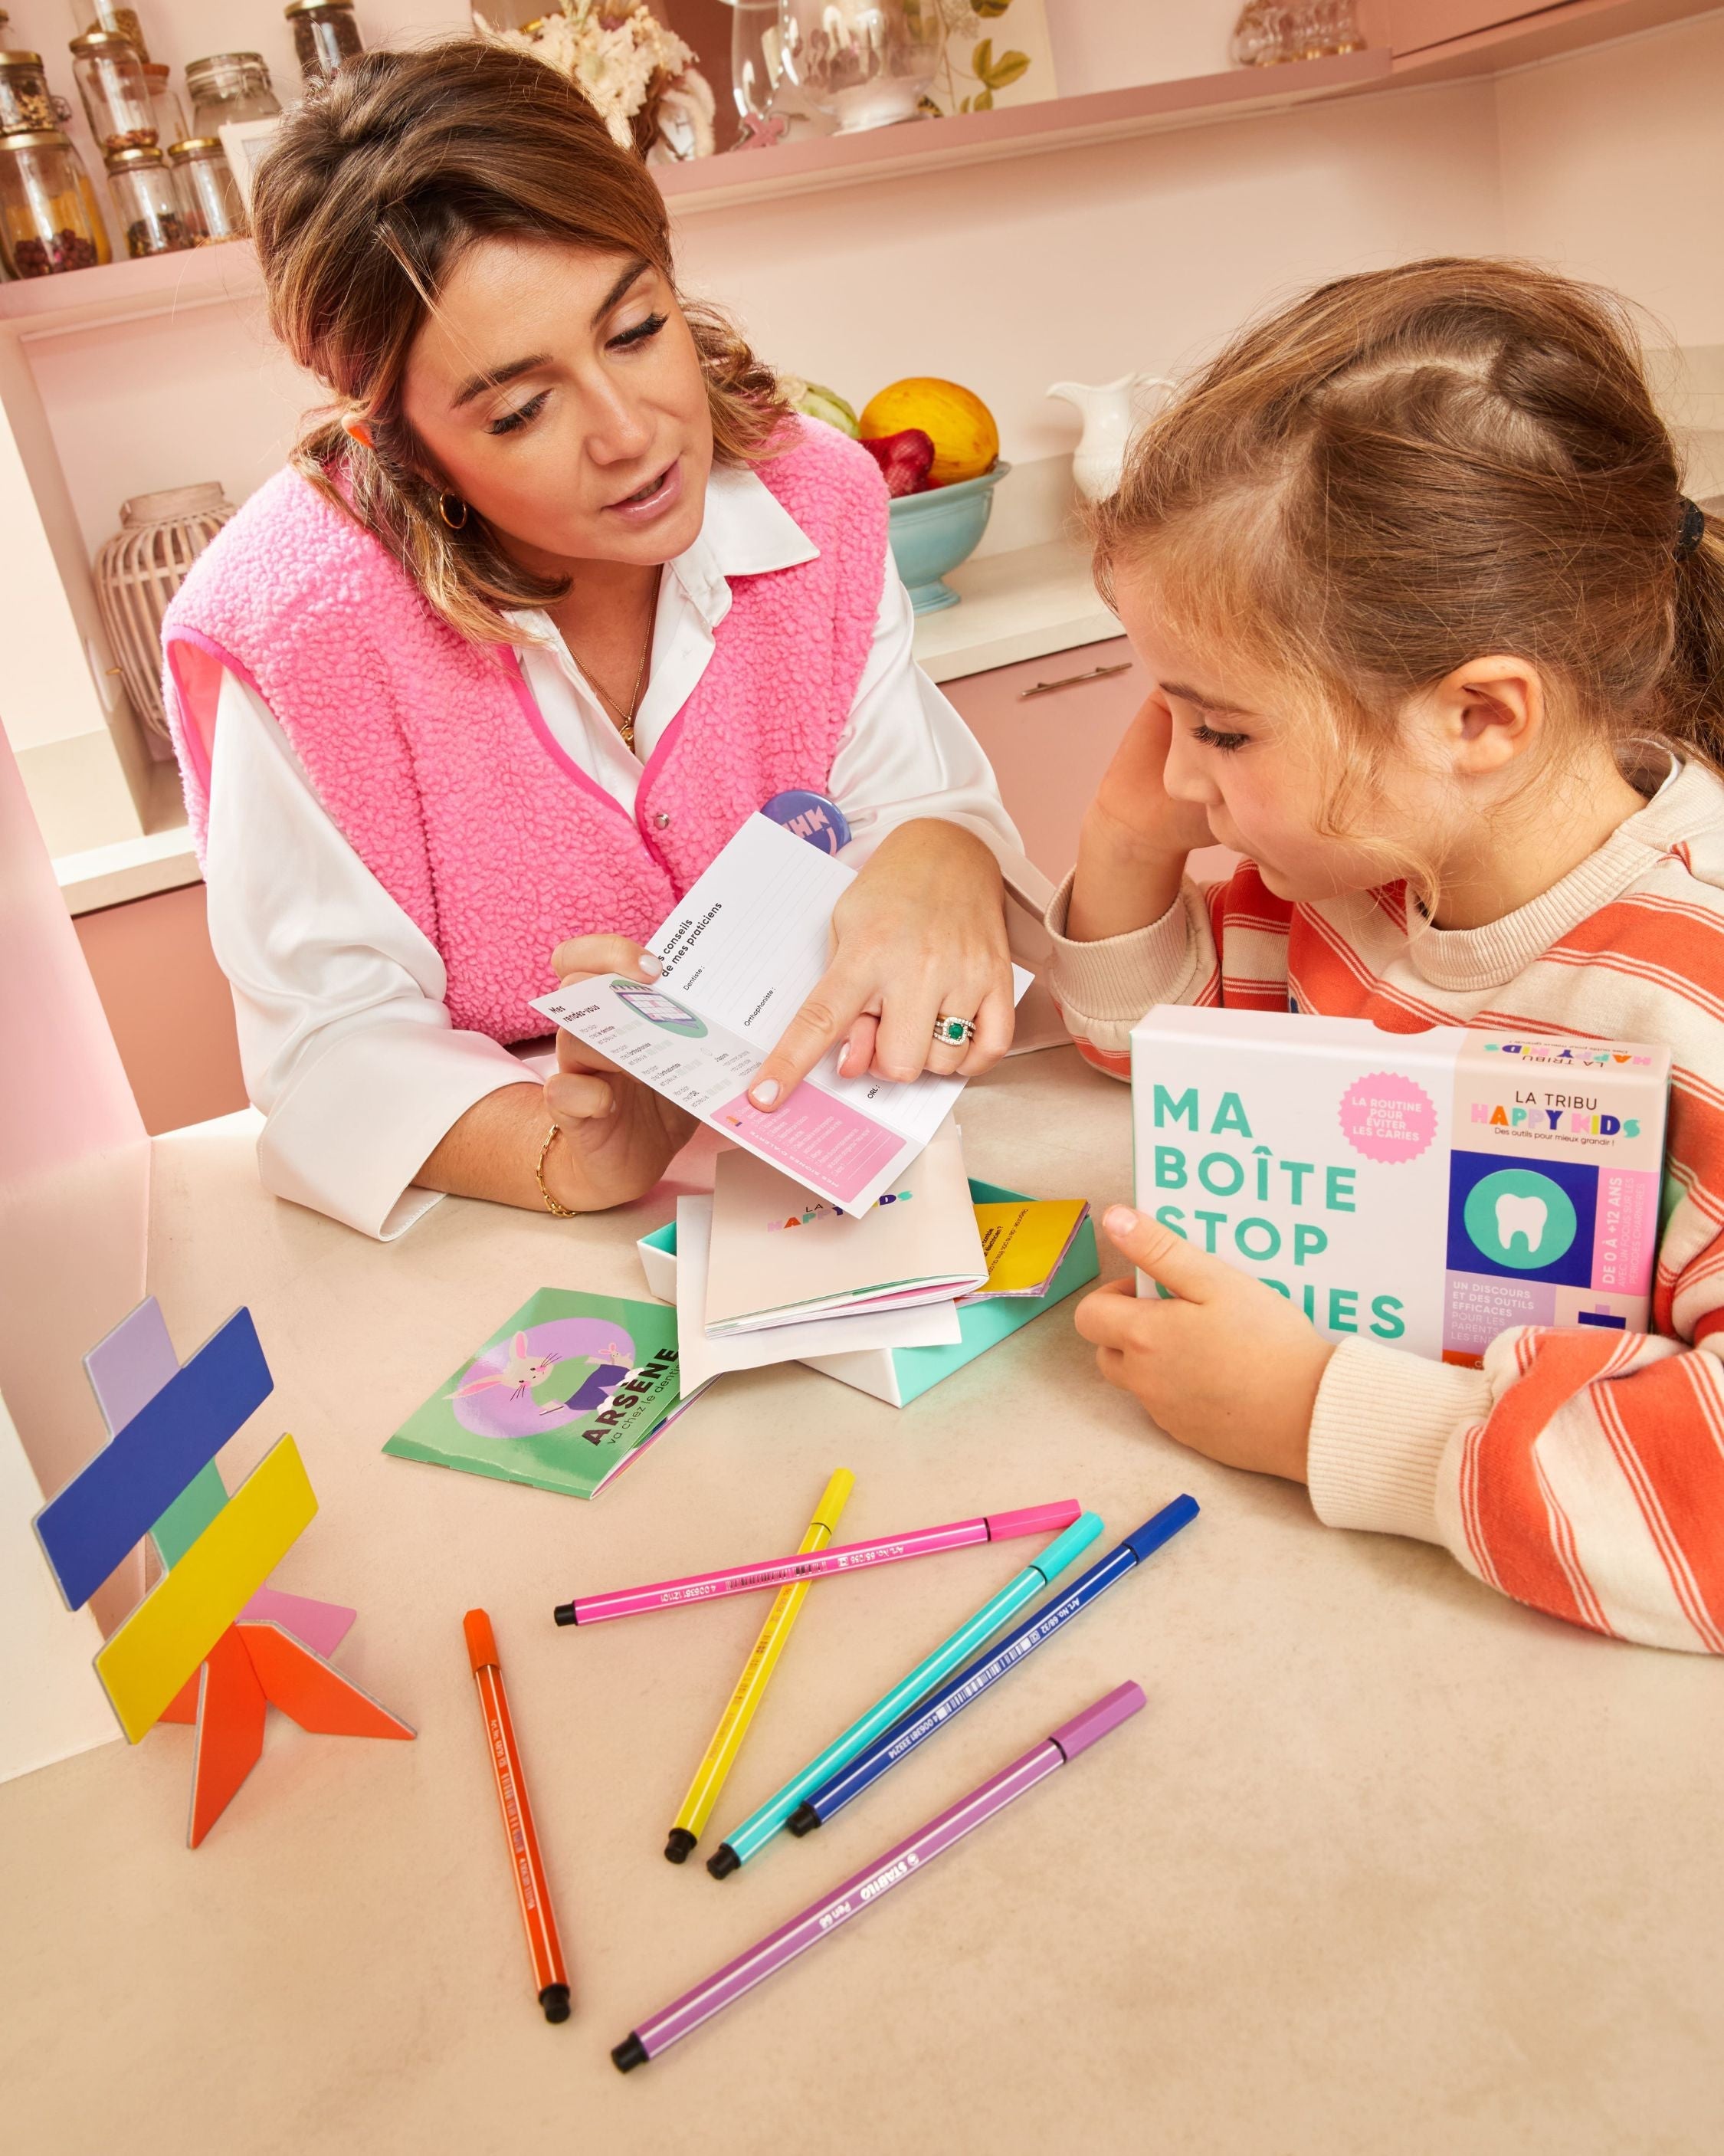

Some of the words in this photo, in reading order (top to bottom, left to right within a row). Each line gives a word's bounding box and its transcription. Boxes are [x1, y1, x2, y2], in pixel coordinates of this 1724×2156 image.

[782, 805, 830, 838] HK
[662, 964, 674, 977] de
[672, 945, 689, 964] mes
[687, 902, 723, 946] praticiens
[664, 919, 693, 954] conseils
[683, 968, 703, 991] Dentiste
[548, 1005, 565, 1016] Mes
[563, 1004, 601, 1022] rendez-vous
[1522, 1055, 1575, 1065] TRIBU
[1556, 1049, 1651, 1065] HAPPY
[867, 1088, 878, 1099] ORL
[1516, 1091, 1537, 1104] LA
[1545, 1093, 1598, 1111] TRIBU
[1153, 1085, 1253, 1138] MA
[1352, 1097, 1367, 1107] LA
[1370, 1098, 1422, 1112] ROUTINE
[1366, 1116, 1407, 1129] ÉVITER
[1370, 1108, 1403, 1120] POUR
[1471, 1103, 1564, 1131] HAPPY
[1571, 1112, 1641, 1138] KIDS
[1352, 1126, 1373, 1136] LES
[1376, 1129, 1420, 1141] CARIES
[1555, 1134, 1578, 1143] mieux
[1581, 1137, 1610, 1146] grandir
[1155, 1145, 1356, 1213] BOÎTE
[1625, 1177, 1634, 1193] LES
[1608, 1176, 1622, 1207] ANS
[806, 1203, 824, 1213] LA
[1624, 1196, 1632, 1213] SUR
[1606, 1211, 1620, 1233] +12
[1621, 1215, 1631, 1246] FOCUS
[1155, 1206, 1328, 1266] STOP
[1602, 1239, 1617, 1249] À
[1602, 1265, 1616, 1285] DE
[1618, 1265, 1627, 1288] AVEC
[1454, 1281, 1468, 1290] UN
[1472, 1283, 1530, 1299] DISCOURS
[1452, 1301, 1513, 1317] EFFICACES
[1453, 1291, 1465, 1300] ET
[1470, 1294, 1490, 1303] DES
[1494, 1297, 1534, 1310] OUTILS
[1452, 1311, 1483, 1323] POUR
[1486, 1316, 1505, 1326] LES
[1451, 1331, 1470, 1341] LES
[582, 1348, 678, 1446] ARSÈNE
[607, 1432, 623, 1444] va
[622, 1406, 646, 1429] chez
[641, 1395, 656, 1404] le
[1057, 1606, 1070, 1618] No.
[1067, 1597, 1080, 1610] Art.
[1041, 1616, 1059, 1635] 68/32
[910, 1718, 934, 1741] 006381
[860, 1861, 908, 1900] STABILO
[831, 1901, 851, 1919] Pen
